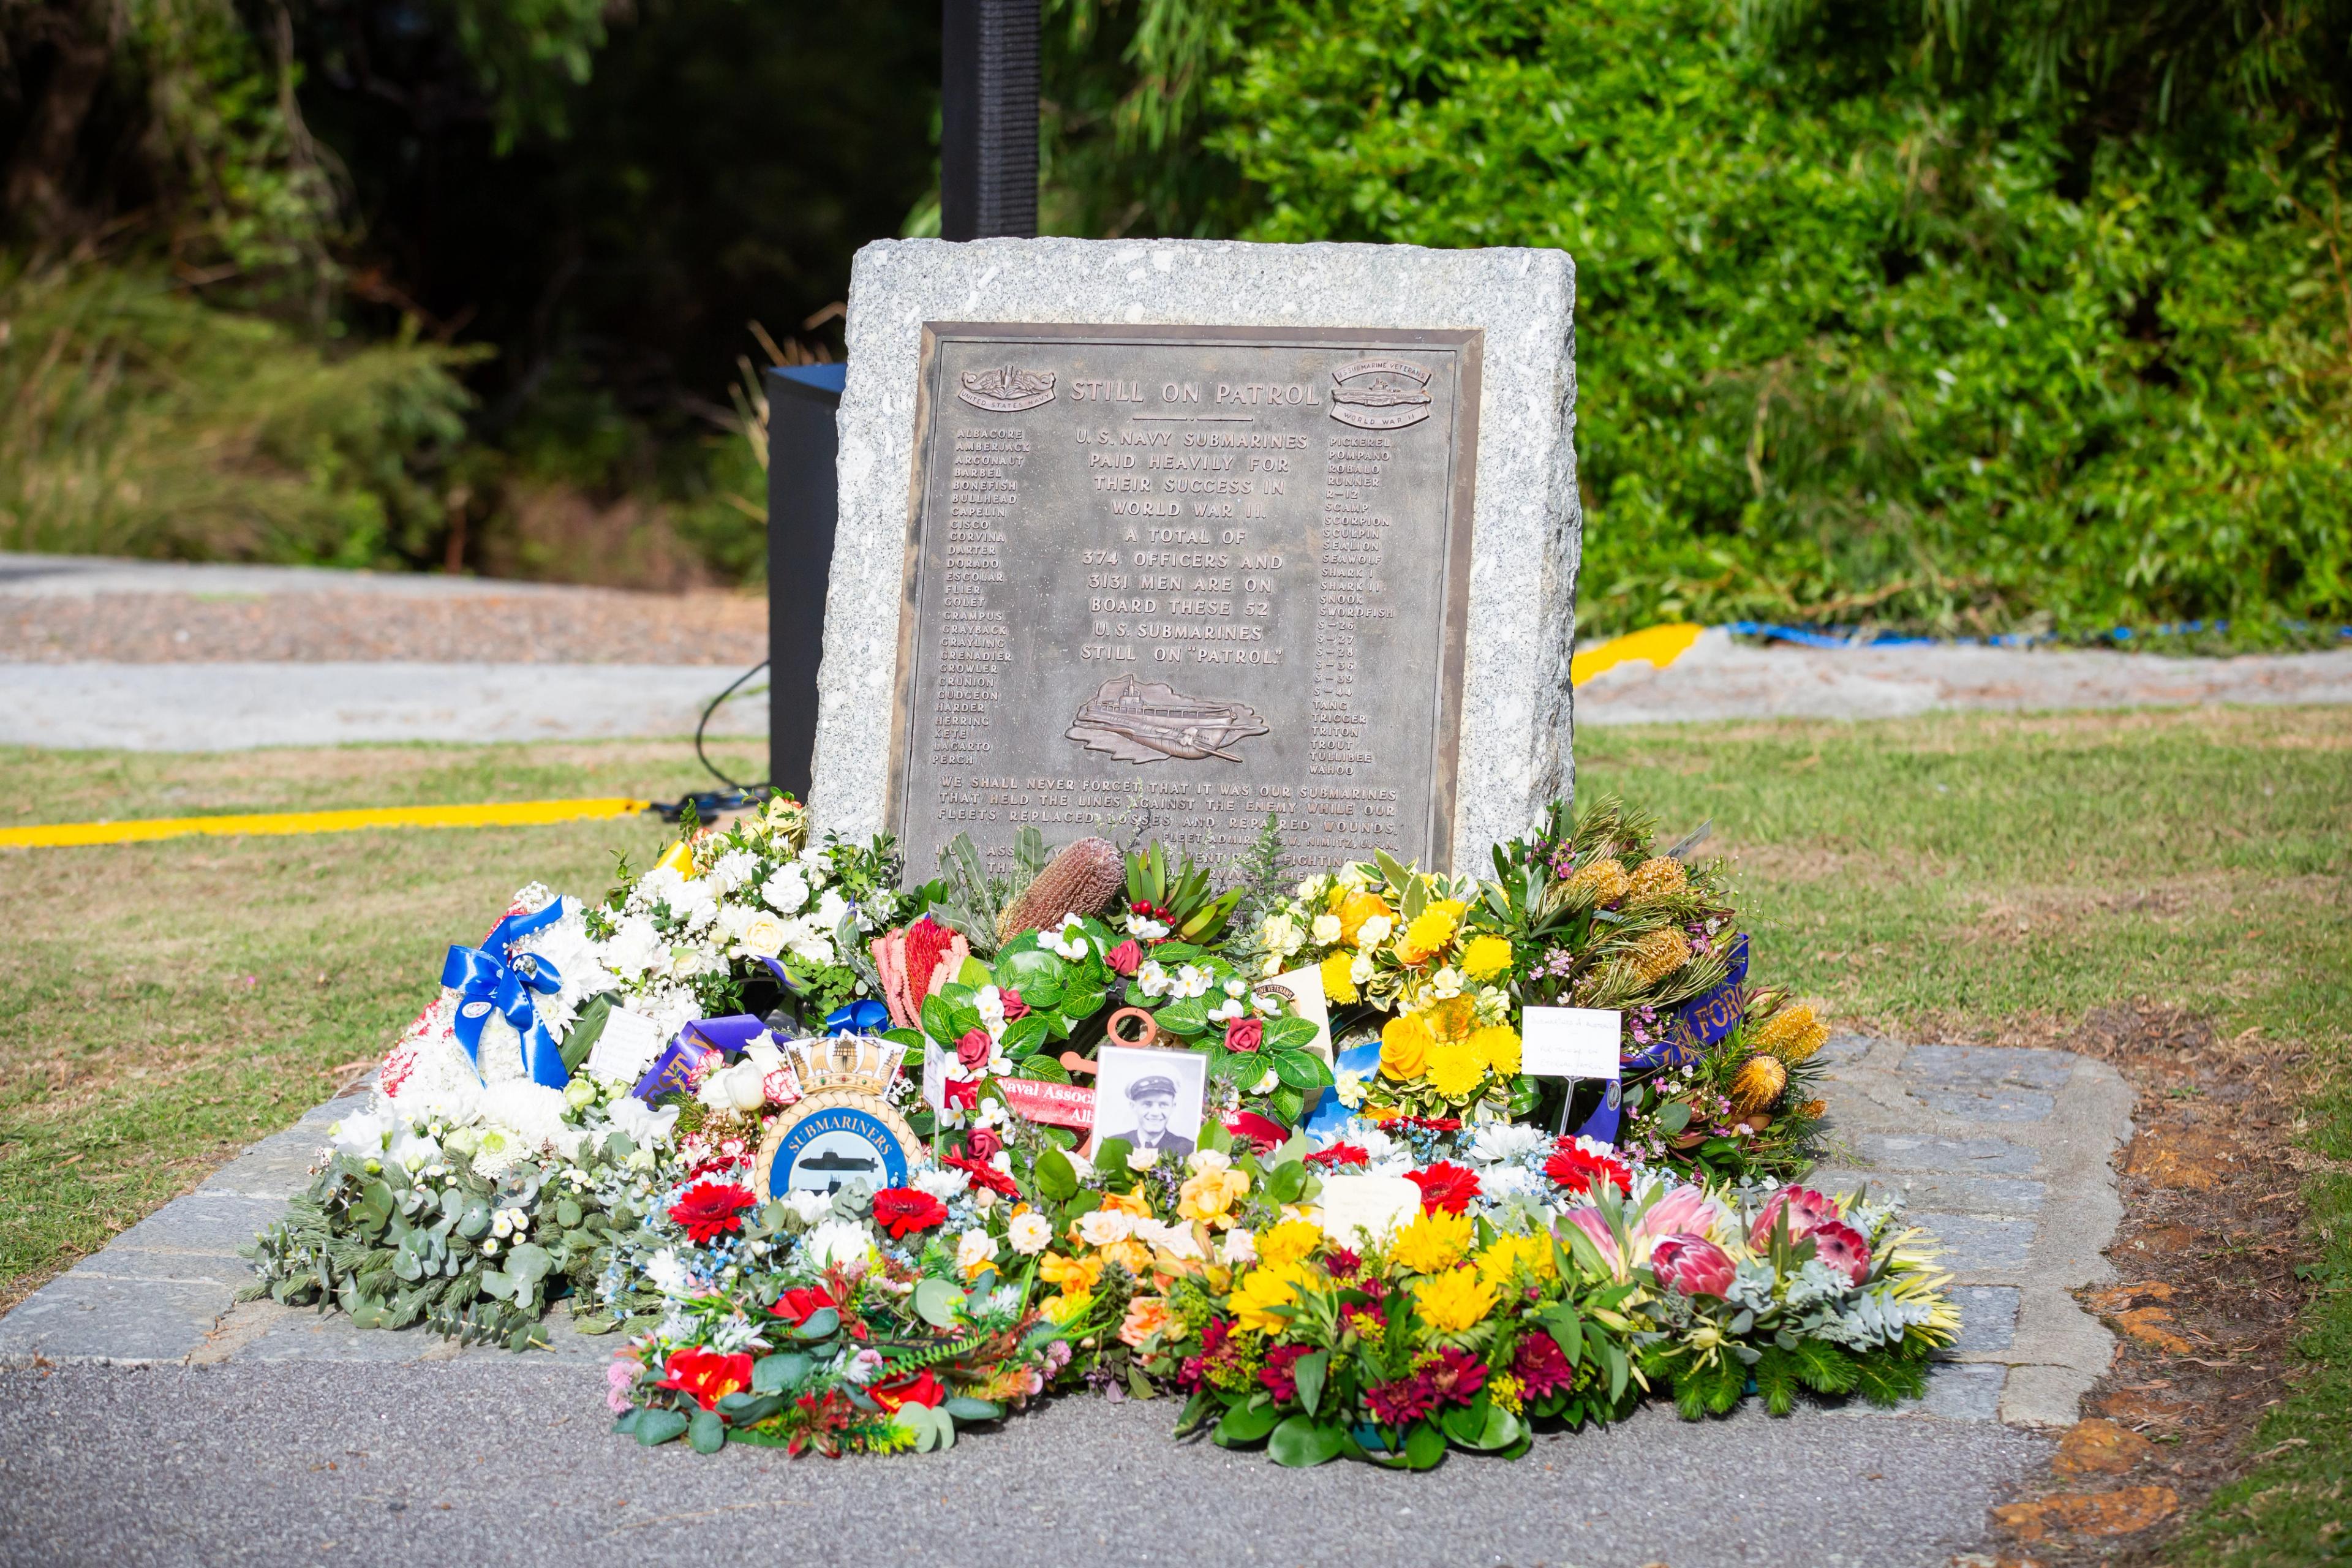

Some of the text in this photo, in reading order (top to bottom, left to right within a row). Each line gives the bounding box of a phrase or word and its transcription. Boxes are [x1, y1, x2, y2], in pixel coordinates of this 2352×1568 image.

[1390, 364, 1425, 379] VETERANS
[962, 391, 986, 405] UNITED
[1028, 393, 1049, 404] NAVY
[1069, 382, 1320, 405] STILL ON PATROL
[1344, 412, 1375, 424] WORLD
[1382, 416, 1402, 425] WAR
[957, 429, 1023, 439] ALBACORE
[1120, 431, 1172, 447] NAVY
[1183, 432, 1308, 449] SUBMARINES
[1330, 438, 1390, 447] PICKEREL
[956, 442, 1030, 452] AMBERJACK
[956, 456, 1023, 466] ARGONAUT
[1329, 451, 1390, 461] POMPANO
[1089, 454, 1289, 472] PAID HEAVILY FOR
[954, 469, 1001, 478] BARBEL
[1329, 464, 1380, 474] ROBALO
[953, 481, 1016, 491] BONEFISH
[1093, 477, 1285, 495] THEIR SUCCESS IN
[1328, 477, 1379, 487] RUNNER
[952, 494, 1017, 504] BULLHEAD
[952, 508, 1005, 517] CAPELIN
[1112, 501, 1267, 519] WORLD WAR II.
[1325, 503, 1368, 513] SCAMP
[951, 521, 989, 530] CISCO
[1325, 516, 1390, 526] SCORPION
[951, 532, 1005, 542] CORVINA
[1125, 528, 1246, 545] A TOTAL OF
[1324, 529, 1379, 539] SCULPIN
[948, 546, 996, 555] DARTER
[1323, 541, 1379, 551] SEALION
[947, 559, 999, 568] DORADO
[1082, 552, 1283, 569] 374 OFFICERS AND
[1322, 554, 1381, 565] SEAWOLF
[946, 573, 1003, 582] ESCOLAR
[1322, 568, 1373, 578] SHARK I
[1088, 574, 1272, 593] 3131 MEN ARE ON
[1321, 582, 1380, 592] SHARK II
[945, 586, 981, 594] FLIER
[944, 598, 985, 608] GOLET
[1319, 595, 1363, 605] SNOOK
[1091, 598, 1268, 616] BOARD THESE 52
[944, 611, 1003, 621] GRAMPUS
[1319, 607, 1394, 618] SWORDFISH
[943, 625, 1006, 635] GRAYBACK
[1137, 624, 1262, 641] SUBMARINES
[941, 638, 1005, 648] GRAYLING
[941, 651, 1011, 662] GRENADIER
[1080, 646, 1136, 661] STILL
[1154, 647, 1182, 662] ON
[940, 664, 997, 674] GROWLER
[939, 677, 994, 687] GRUNION
[938, 691, 998, 701] GUDGEON
[936, 703, 984, 713] HARDER
[1313, 701, 1347, 710] TANG
[935, 717, 989, 726] HERRING
[1312, 714, 1366, 724] TRIGGER
[935, 729, 967, 739] KETE
[1312, 726, 1359, 737] TRITON
[933, 742, 991, 752] LAGARTO
[1311, 740, 1353, 750] TROUT
[932, 755, 974, 765] PERCH
[1310, 752, 1373, 763] TULLIBEE
[1310, 765, 1354, 775] WAHOO
[941, 776, 1396, 801] WE SHALL NEVER FORGET THAT IT WAS OUR SUBMARINES
[940, 792, 980, 804] THAT
[990, 793, 1029, 805] HELD
[1039, 796, 1068, 806] THE
[1078, 796, 1120, 808] LINES
[1206, 800, 1235, 811] THE
[1245, 801, 1297, 813] ENEMY
[1307, 802, 1354, 815] WHILE
[1364, 805, 1395, 816] OUR
[938, 809, 997, 820] FLEETS
[1009, 811, 1094, 823] REPLACED
[1183, 816, 1215, 827] AND
[1229, 817, 1310, 831] REPARED
[1324, 820, 1398, 835] WOUNDS.
[1163, 833, 1202, 843] FLEET
[1307, 837, 1357, 850] NIMITZ,
[1267, 985, 1292, 998] VETERANS
[788, 1115, 892, 1155] SUBMARINERS
